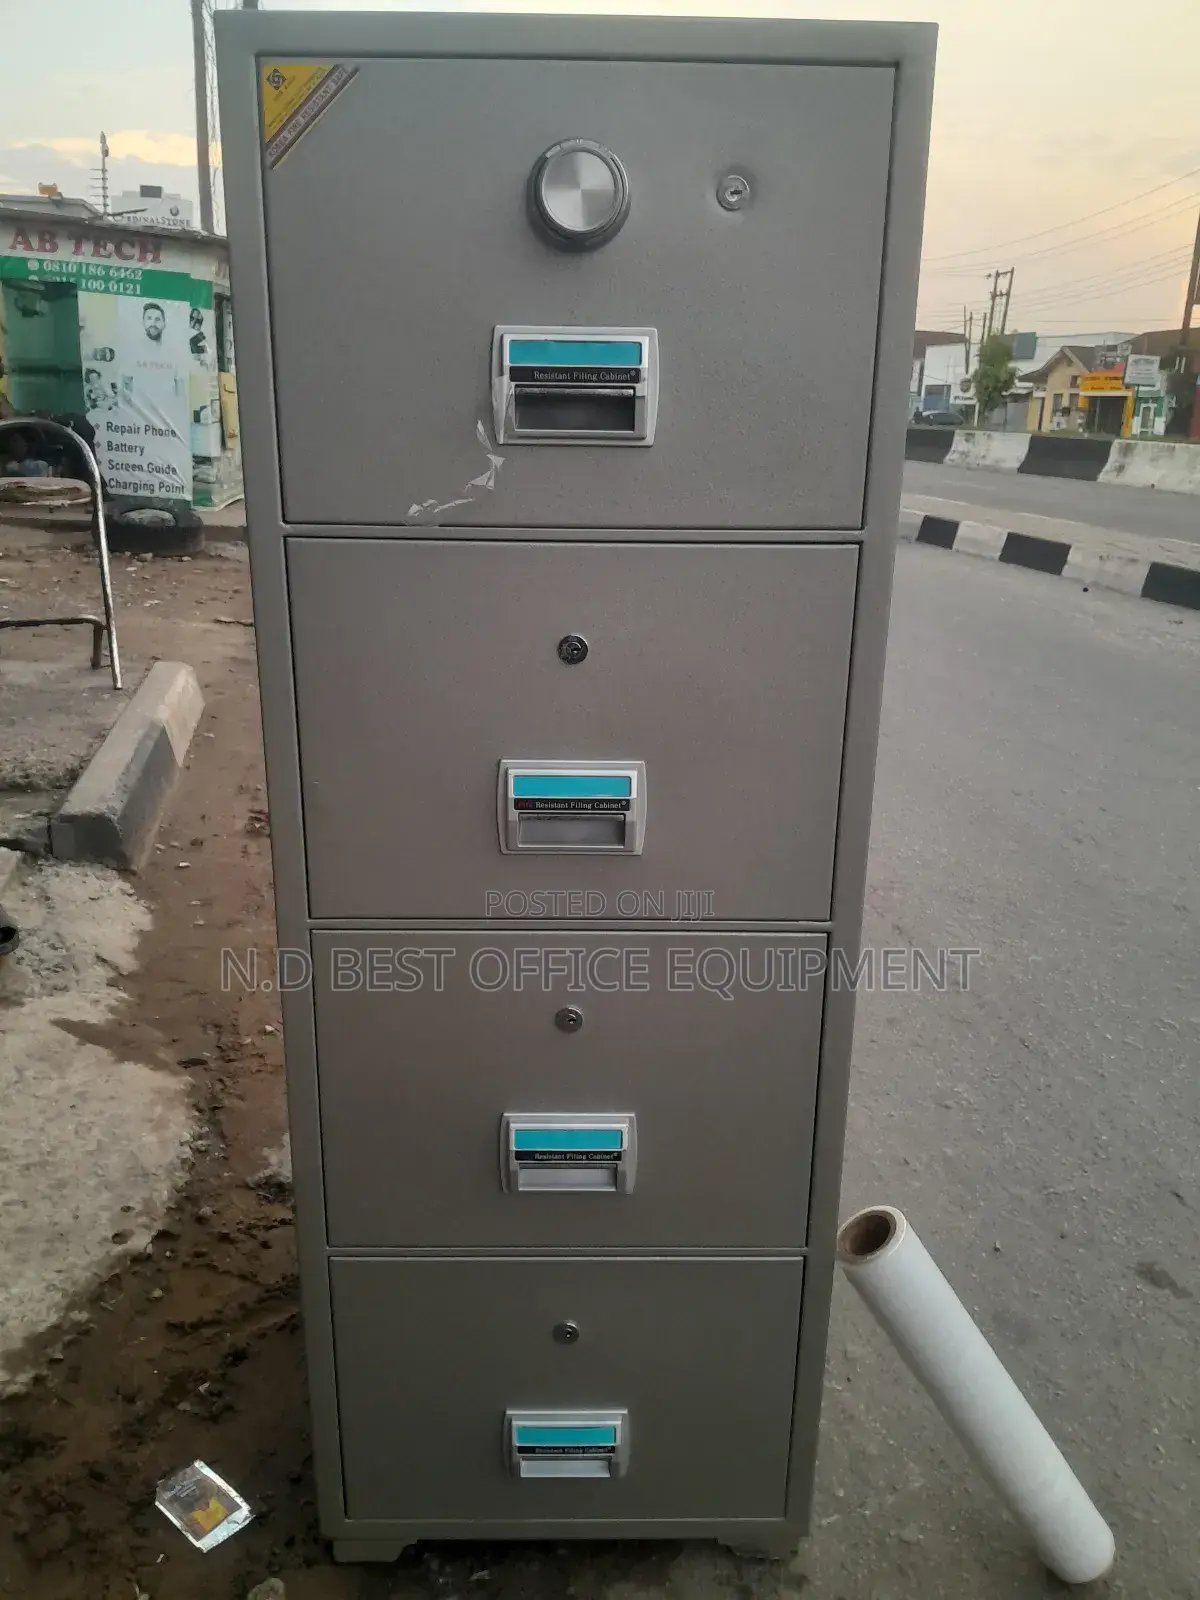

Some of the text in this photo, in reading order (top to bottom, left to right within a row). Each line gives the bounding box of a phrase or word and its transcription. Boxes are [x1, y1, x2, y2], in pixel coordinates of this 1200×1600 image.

[9, 227, 162, 264] AB TECH
[82, 263, 105, 276] 186
[109, 266, 143, 280] 6462
[81, 279, 141, 295] 100 0121
[534, 371, 571, 380] Resistant
[573, 372, 597, 381] Filing
[106, 422, 177, 438] Repair Phone
[106, 441, 145, 456] Battery
[108, 460, 177, 476] Screen Guide
[108, 478, 185, 494] Charging Point
[570, 802, 592, 810] Filing
[567, 1153, 587, 1161] Filing
